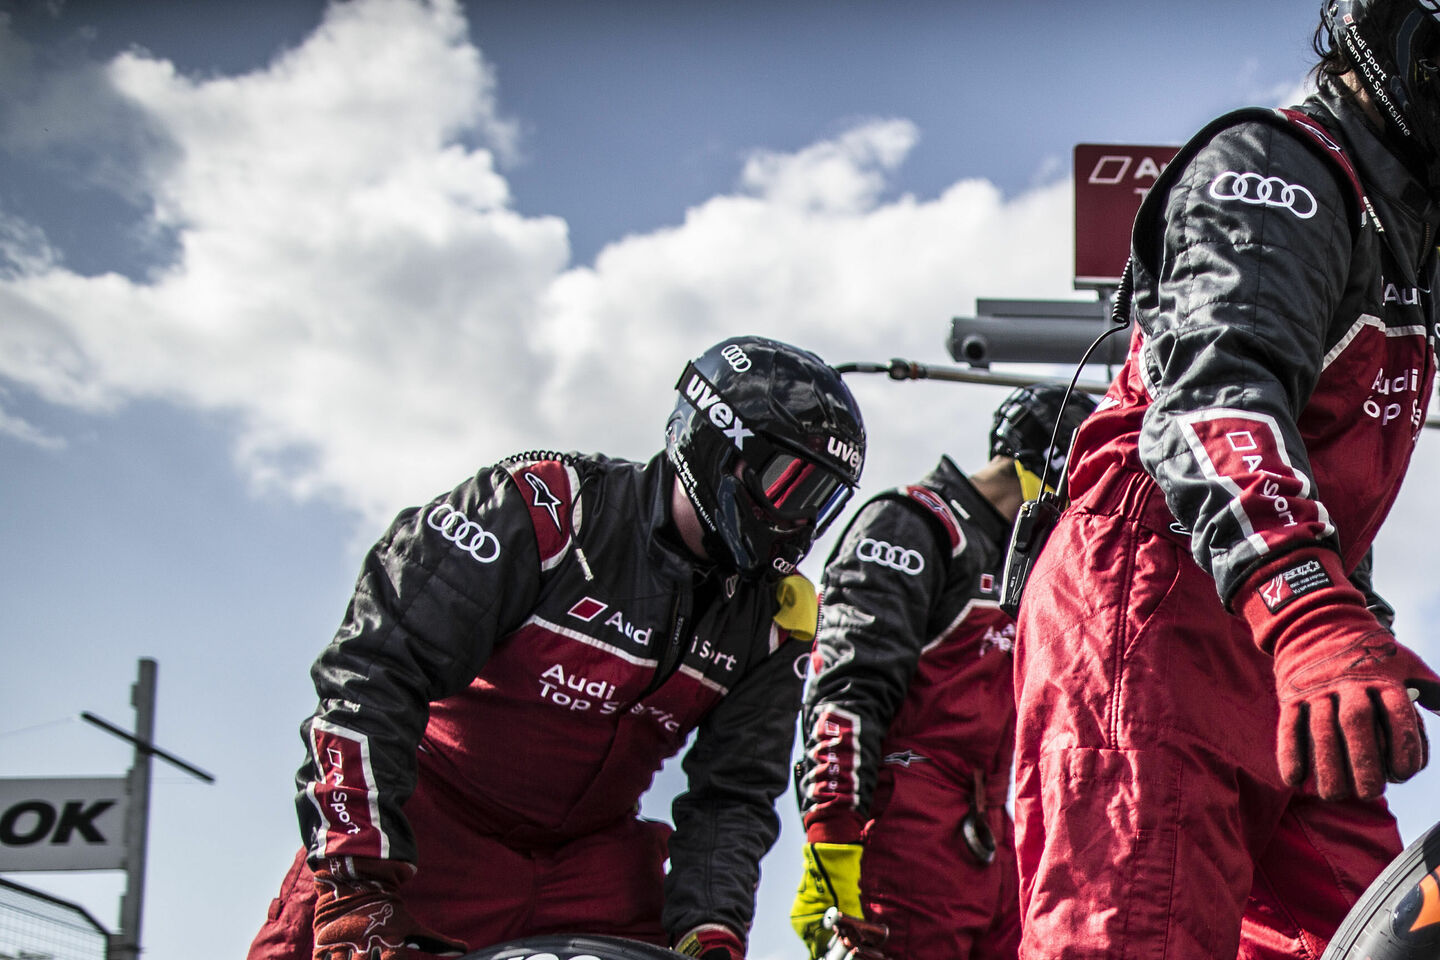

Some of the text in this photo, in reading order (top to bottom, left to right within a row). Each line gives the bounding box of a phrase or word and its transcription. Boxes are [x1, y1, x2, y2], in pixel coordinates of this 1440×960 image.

[1349, 24, 1388, 82] Audi Sport
[1343, 32, 1411, 137] Team Abt Sportsline
[685, 373, 756, 451] uvex
[1362, 396, 1401, 426] op
[538, 679, 592, 711] Top
[541, 664, 616, 700] Audi
